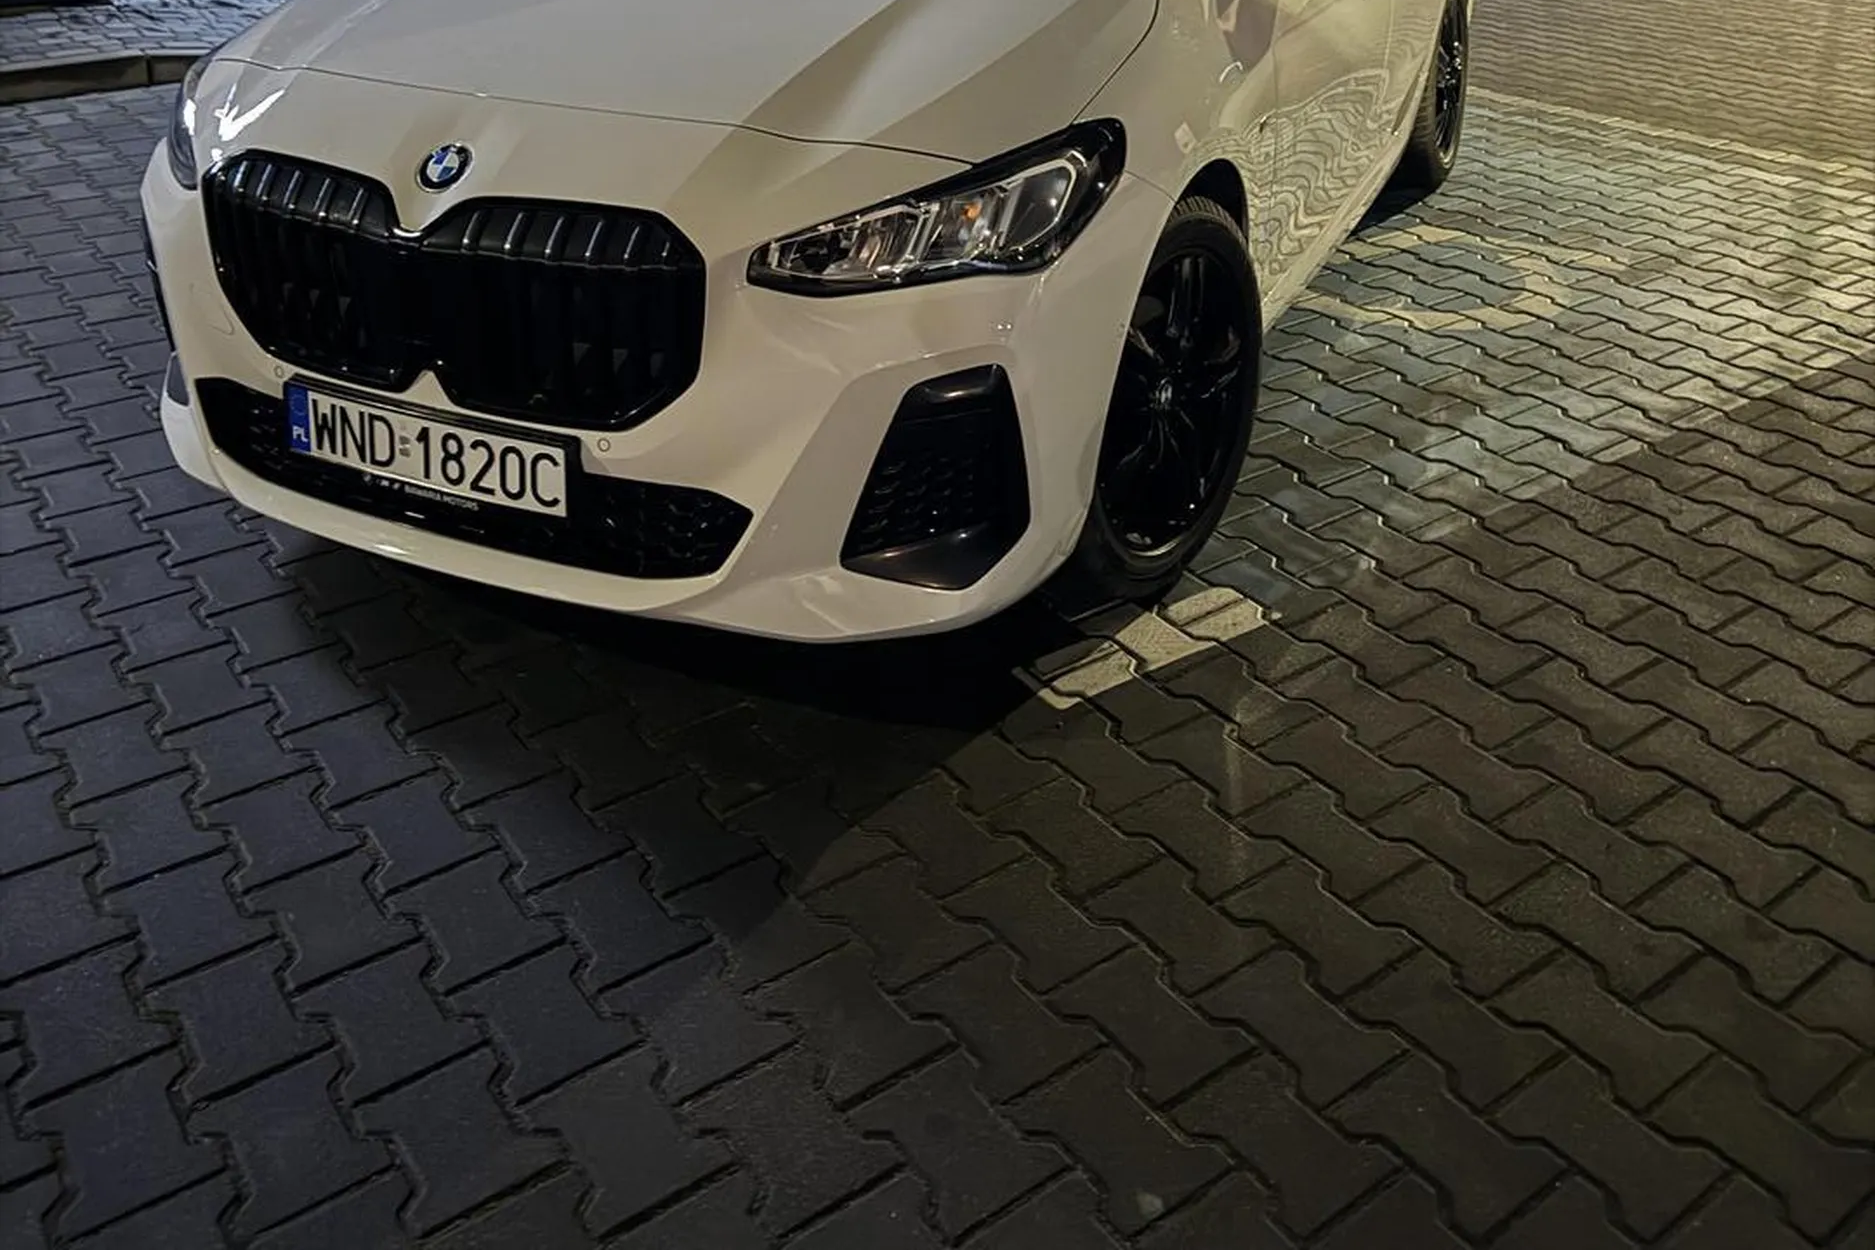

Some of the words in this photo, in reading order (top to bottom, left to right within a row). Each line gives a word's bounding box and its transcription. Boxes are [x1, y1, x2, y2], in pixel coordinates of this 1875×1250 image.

[292, 425, 309, 443] PL
[312, 398, 395, 468] WND
[415, 426, 560, 508] 1820C
